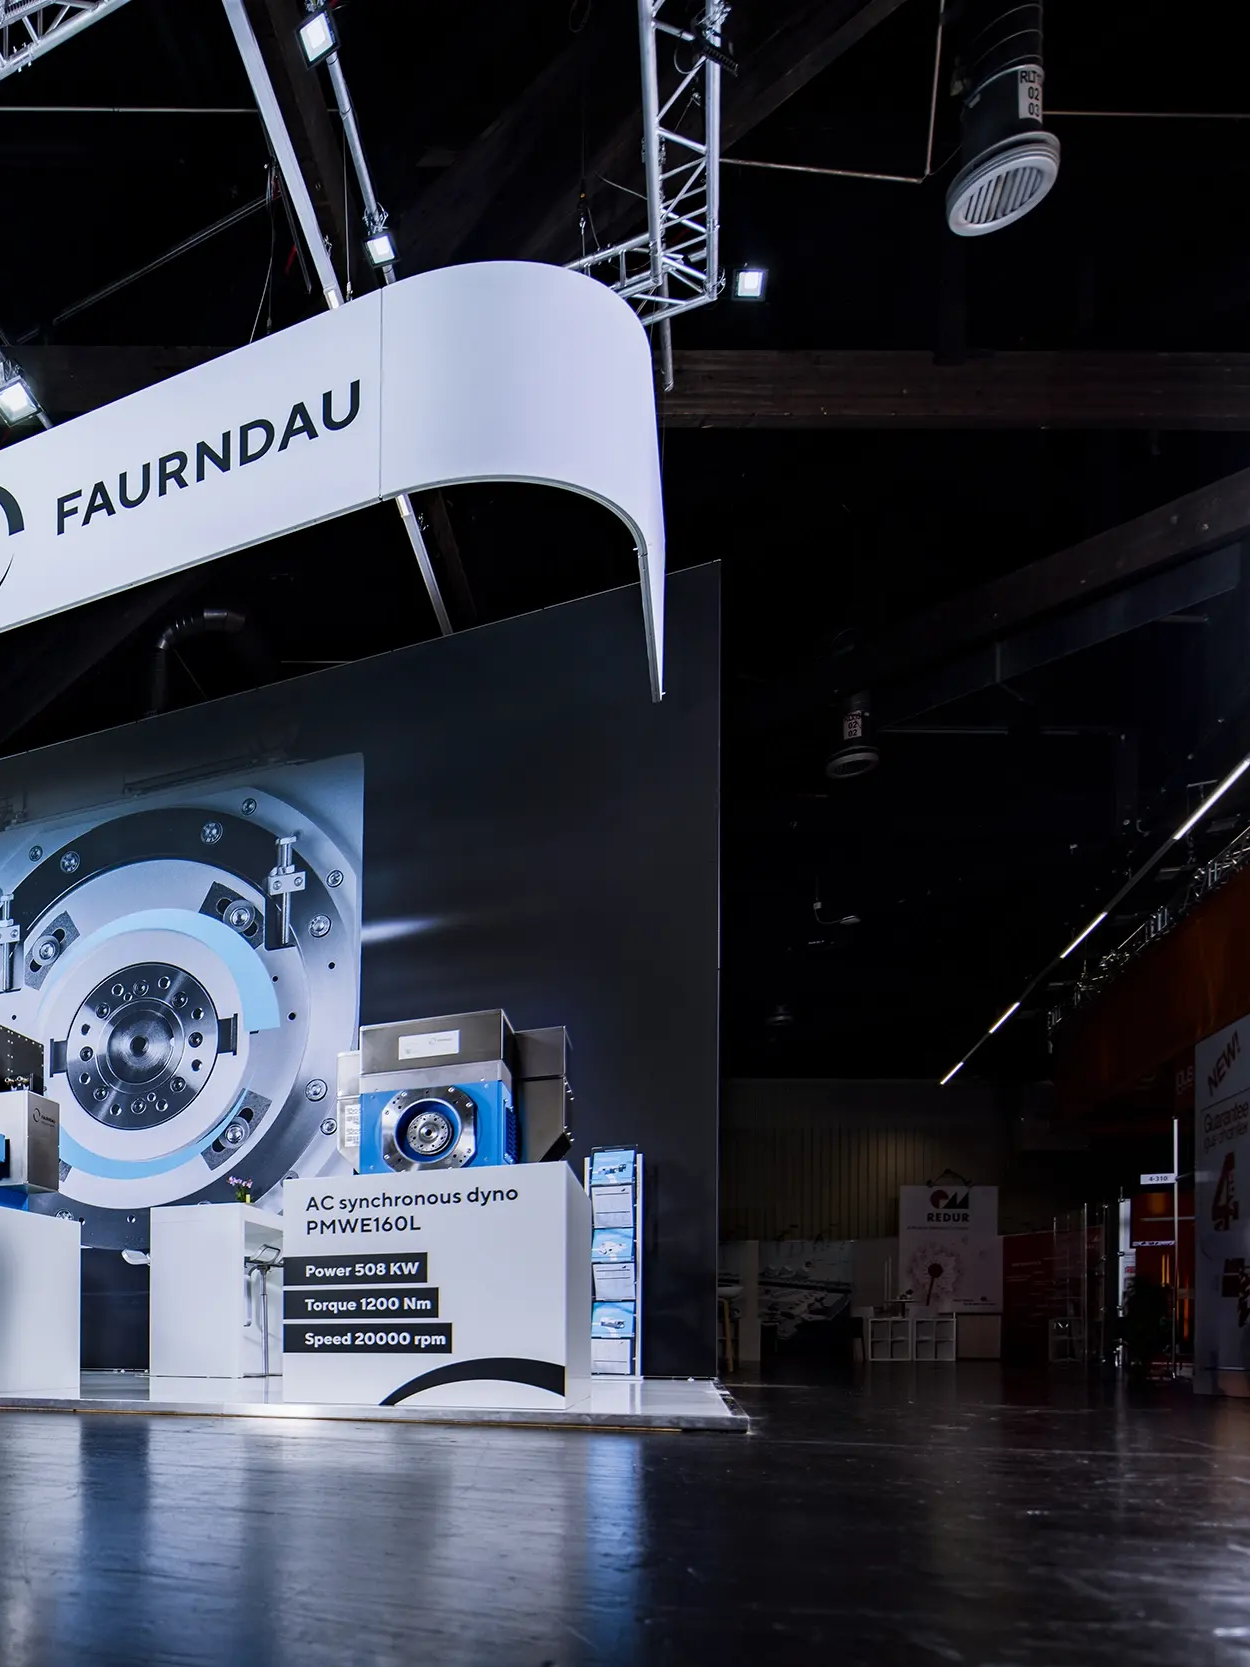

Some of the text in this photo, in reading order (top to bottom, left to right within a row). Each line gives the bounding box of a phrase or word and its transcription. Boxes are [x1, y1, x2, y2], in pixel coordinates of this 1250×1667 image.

[1028, 87, 1040, 101] 02
[1028, 103, 1040, 118] 03
[57, 379, 360, 536] FAURNDAU
[1208, 1030, 1241, 1097] NEW!
[1149, 1174, 1168, 1182] 4-310
[306, 1187, 518, 1213] AC synchronous dyno
[306, 1215, 421, 1235] PMWE160L
[927, 1213, 969, 1222] REDUR
[305, 1262, 420, 1277] Power 508 KW
[305, 1297, 431, 1314] Torque 1200 Nm
[304, 1332, 446, 1348] Speed 20000 rpm
